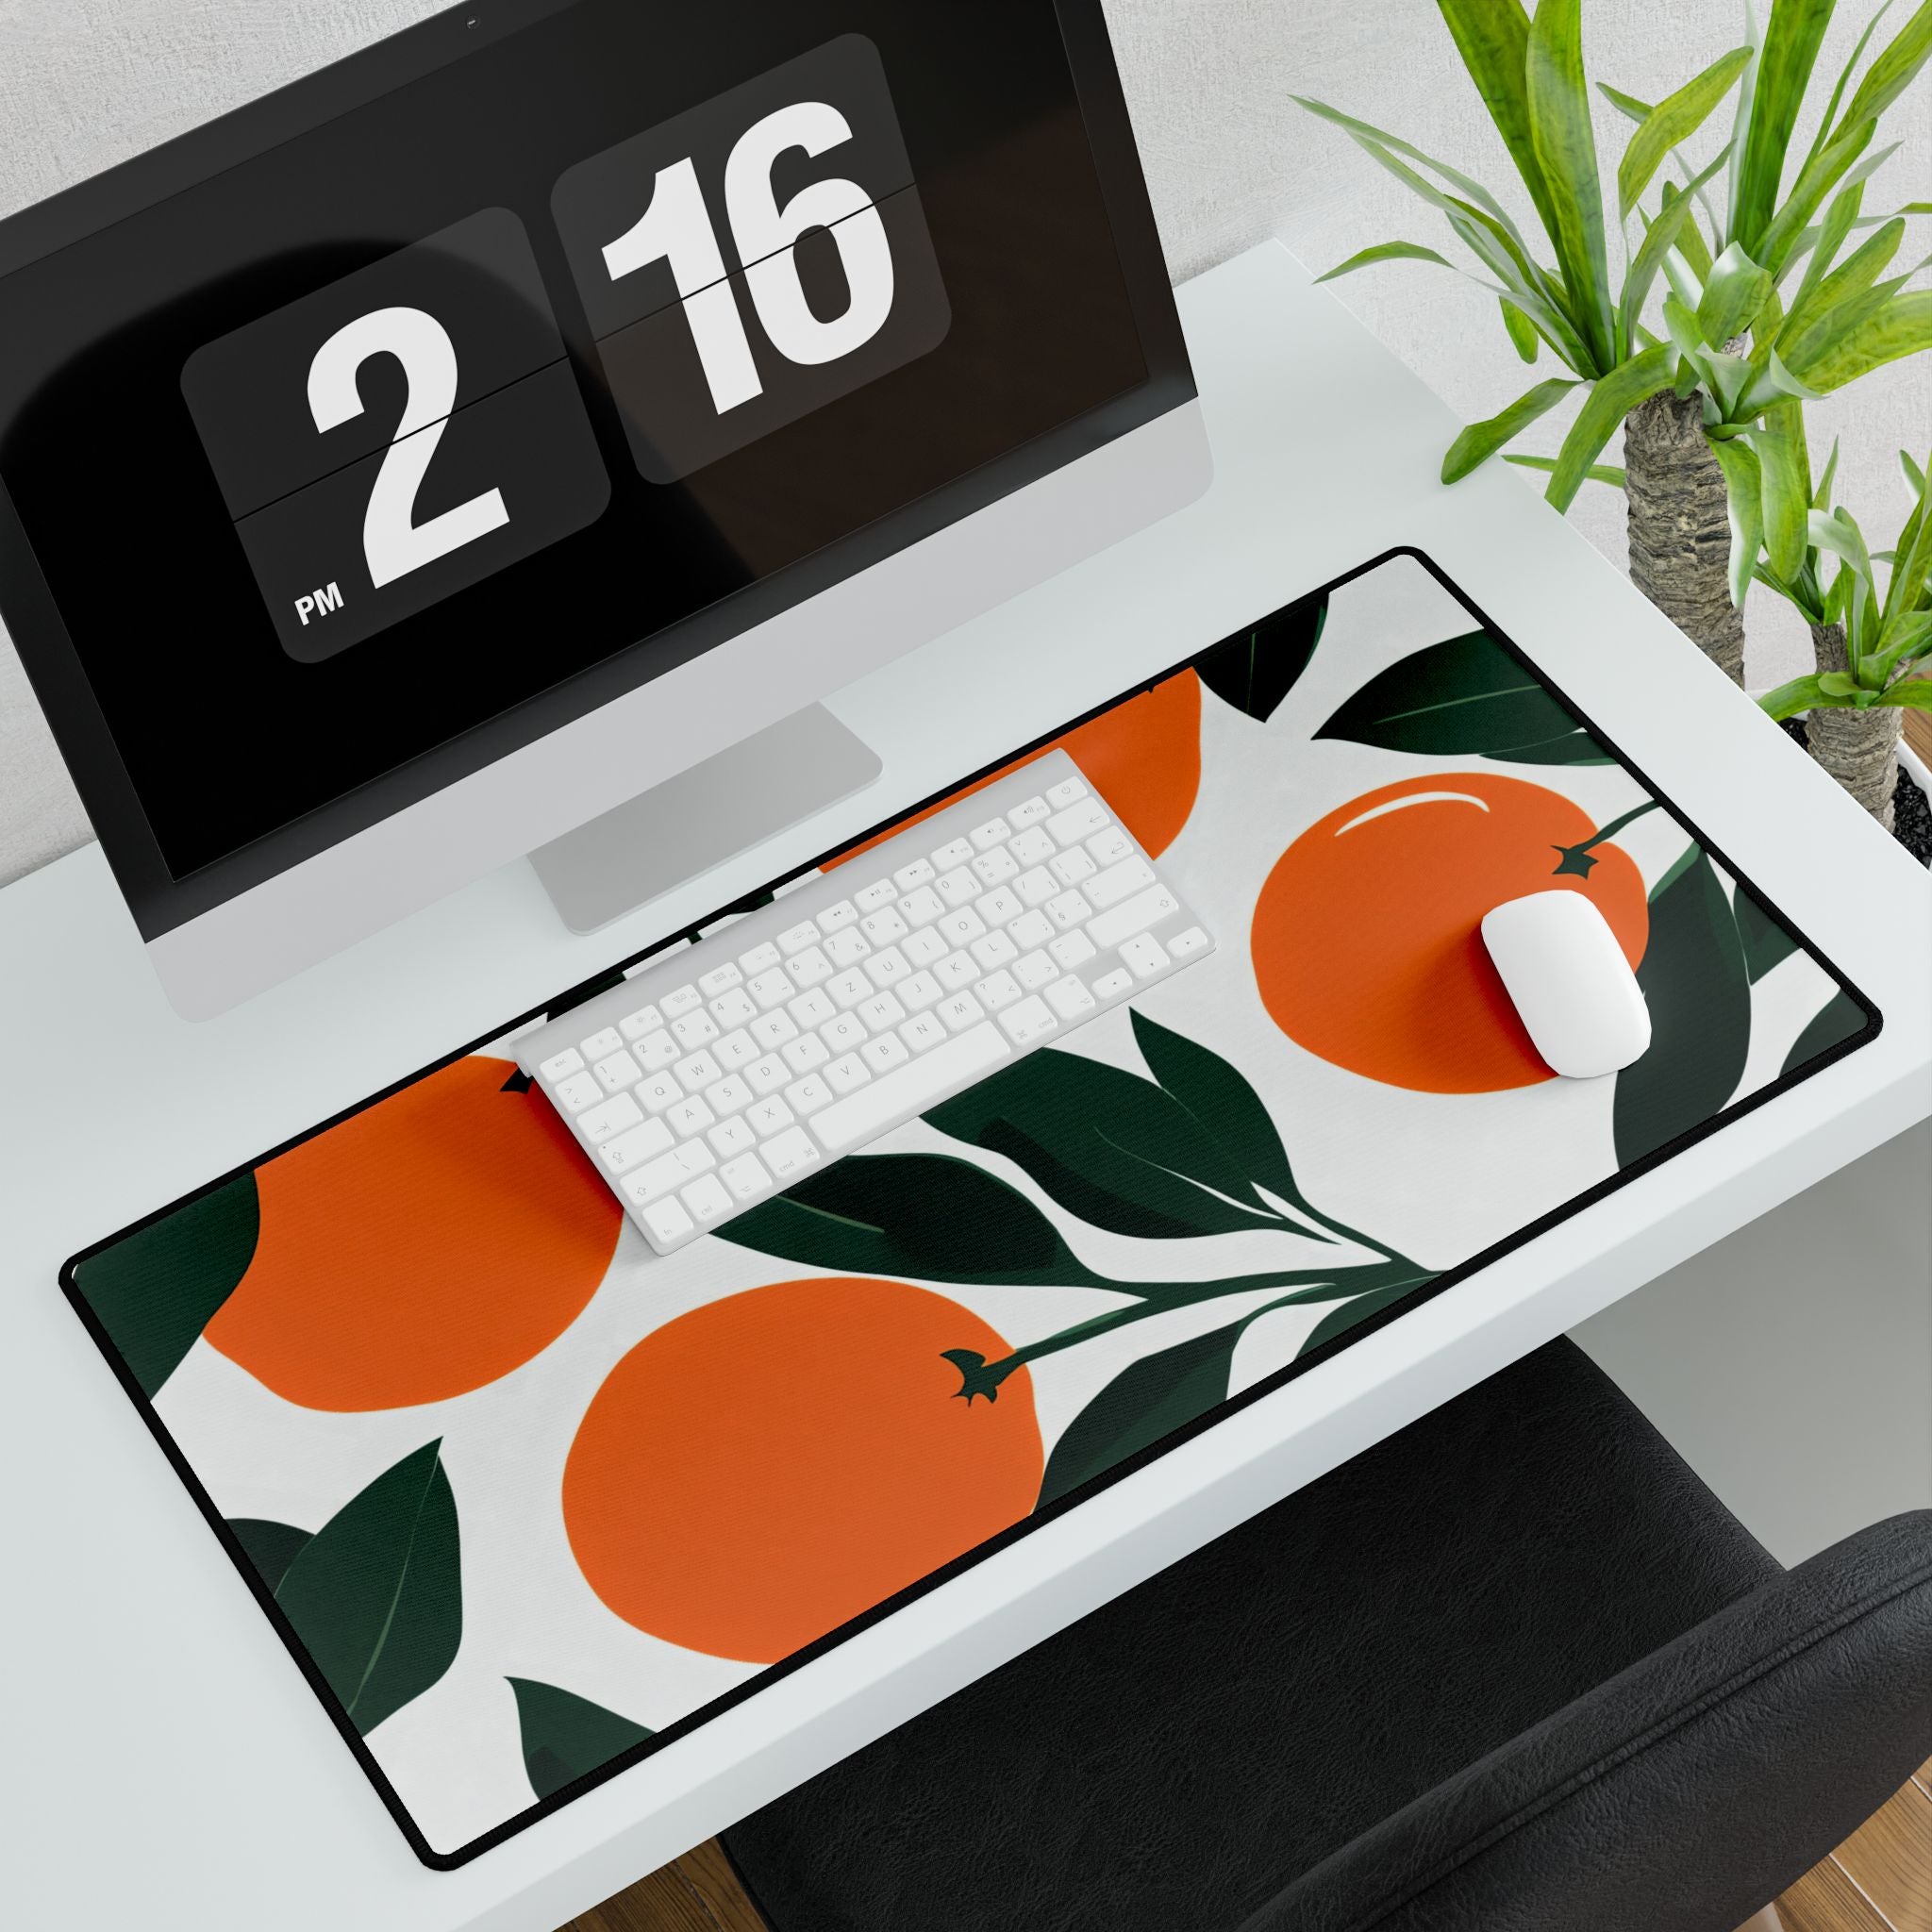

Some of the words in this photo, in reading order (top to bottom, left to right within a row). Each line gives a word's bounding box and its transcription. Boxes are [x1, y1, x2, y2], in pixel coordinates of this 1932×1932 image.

[308, 308, 509, 589] 2
[602, 102, 893, 414] 16
[295, 582, 343, 625] PM
[941, 879, 951, 891] 0
[903, 900, 912, 910] 9
[995, 899, 1004, 911] P
[866, 921, 875, 930] 8
[958, 921, 969, 931] O
[828, 940, 836, 951] 7
[988, 943, 998, 952] L
[792, 961, 800, 971] 6
[882, 960, 893, 973] U
[950, 959, 961, 973] K
[754, 981, 762, 991] 5
[845, 981, 857, 993] Z
[914, 982, 922, 993] J
[717, 1002, 724, 1011] 4
[808, 1003, 817, 1012] T
[874, 1003, 886, 1014] H
[954, 1003, 967, 1015] M
[676, 1023, 687, 1033] 3
[770, 1024, 780, 1034] R
[837, 1024, 848, 1035] G
[916, 1024, 929, 1035] N
[638, 1043, 648, 1055] 2
[731, 1043, 742, 1055] E
[799, 1044, 807, 1056] F
[877, 1044, 890, 1056] B
[599, 1065, 608, 1074] 1
[691, 1064, 705, 1076] W
[759, 1066, 771, 1078] D
[840, 1065, 850, 1076] V
[654, 1086, 667, 1096] Q
[722, 1087, 732, 1098] S
[803, 1086, 814, 1097] C
[685, 1108, 695, 1121] A
[763, 1107, 775, 1119] X
[724, 1128, 735, 1140] Y
